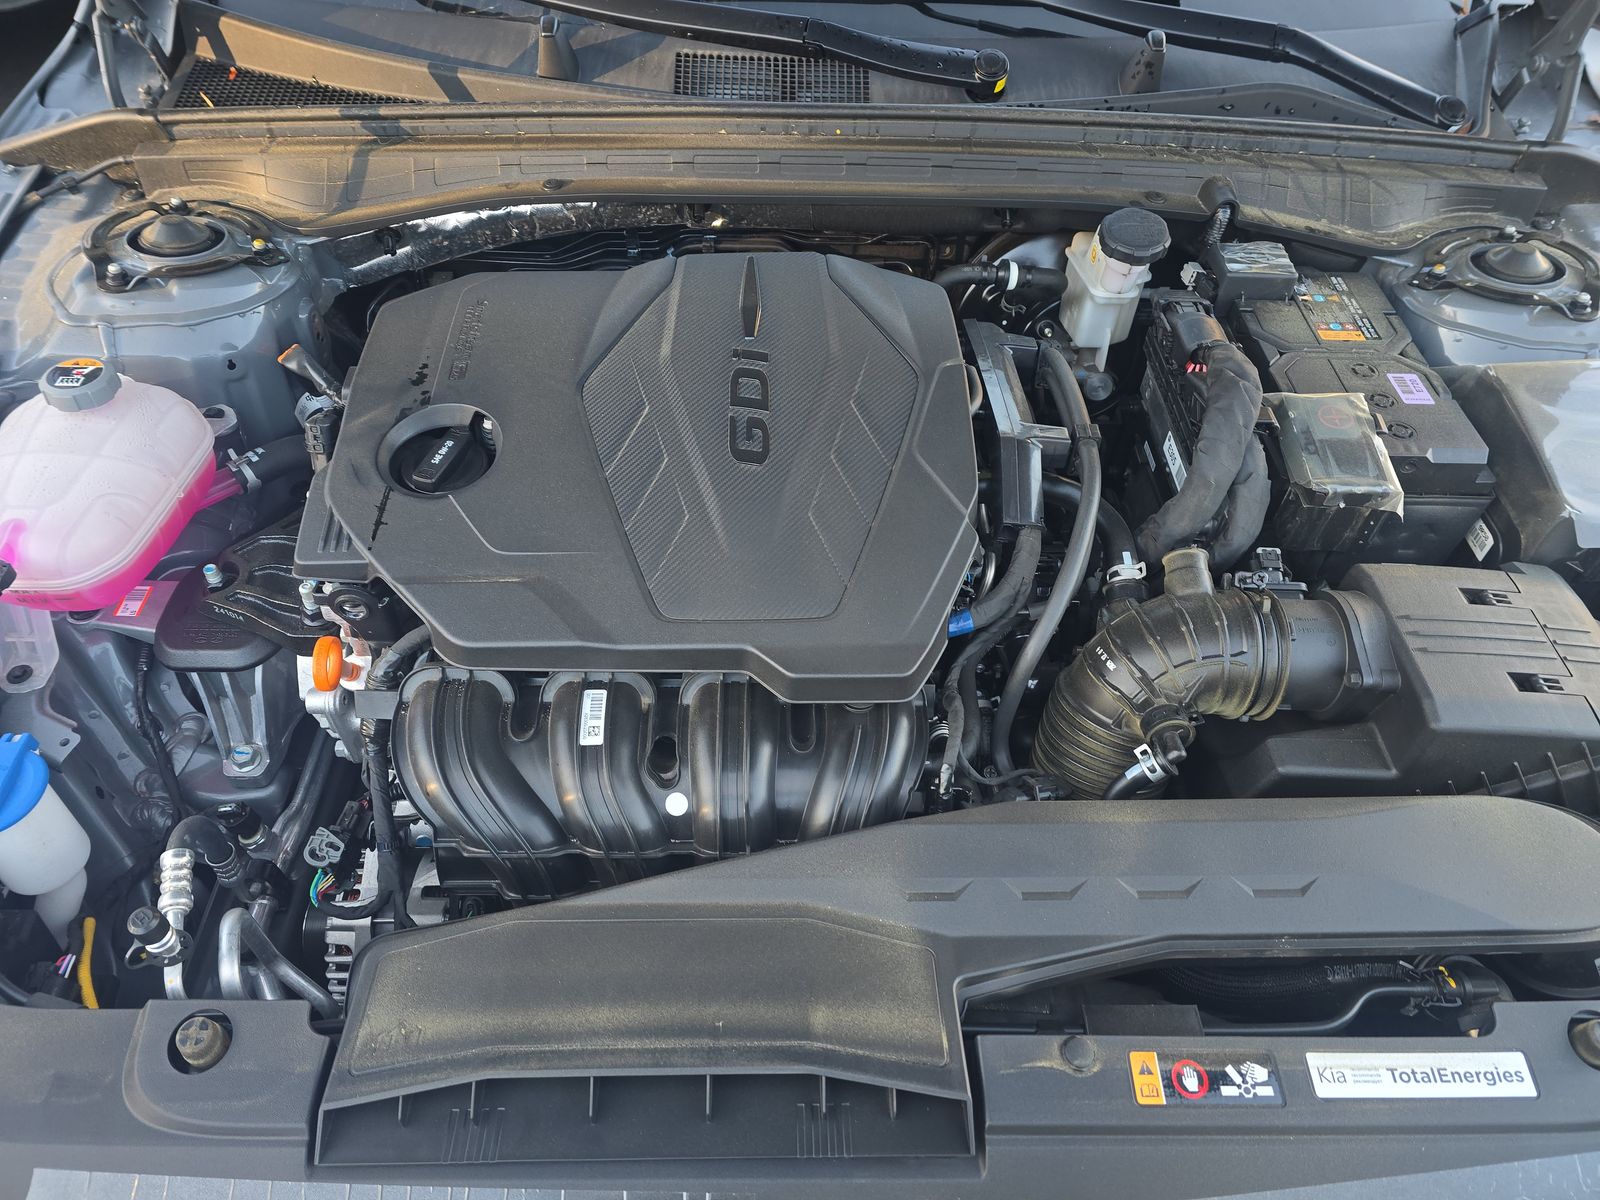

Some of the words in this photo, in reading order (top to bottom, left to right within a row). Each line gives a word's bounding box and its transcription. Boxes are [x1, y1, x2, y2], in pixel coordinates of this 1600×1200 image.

[431, 453, 444, 465] SAE
[1316, 1066, 1347, 1084] Kia
[1386, 1064, 1525, 1086] TotalEnergies
